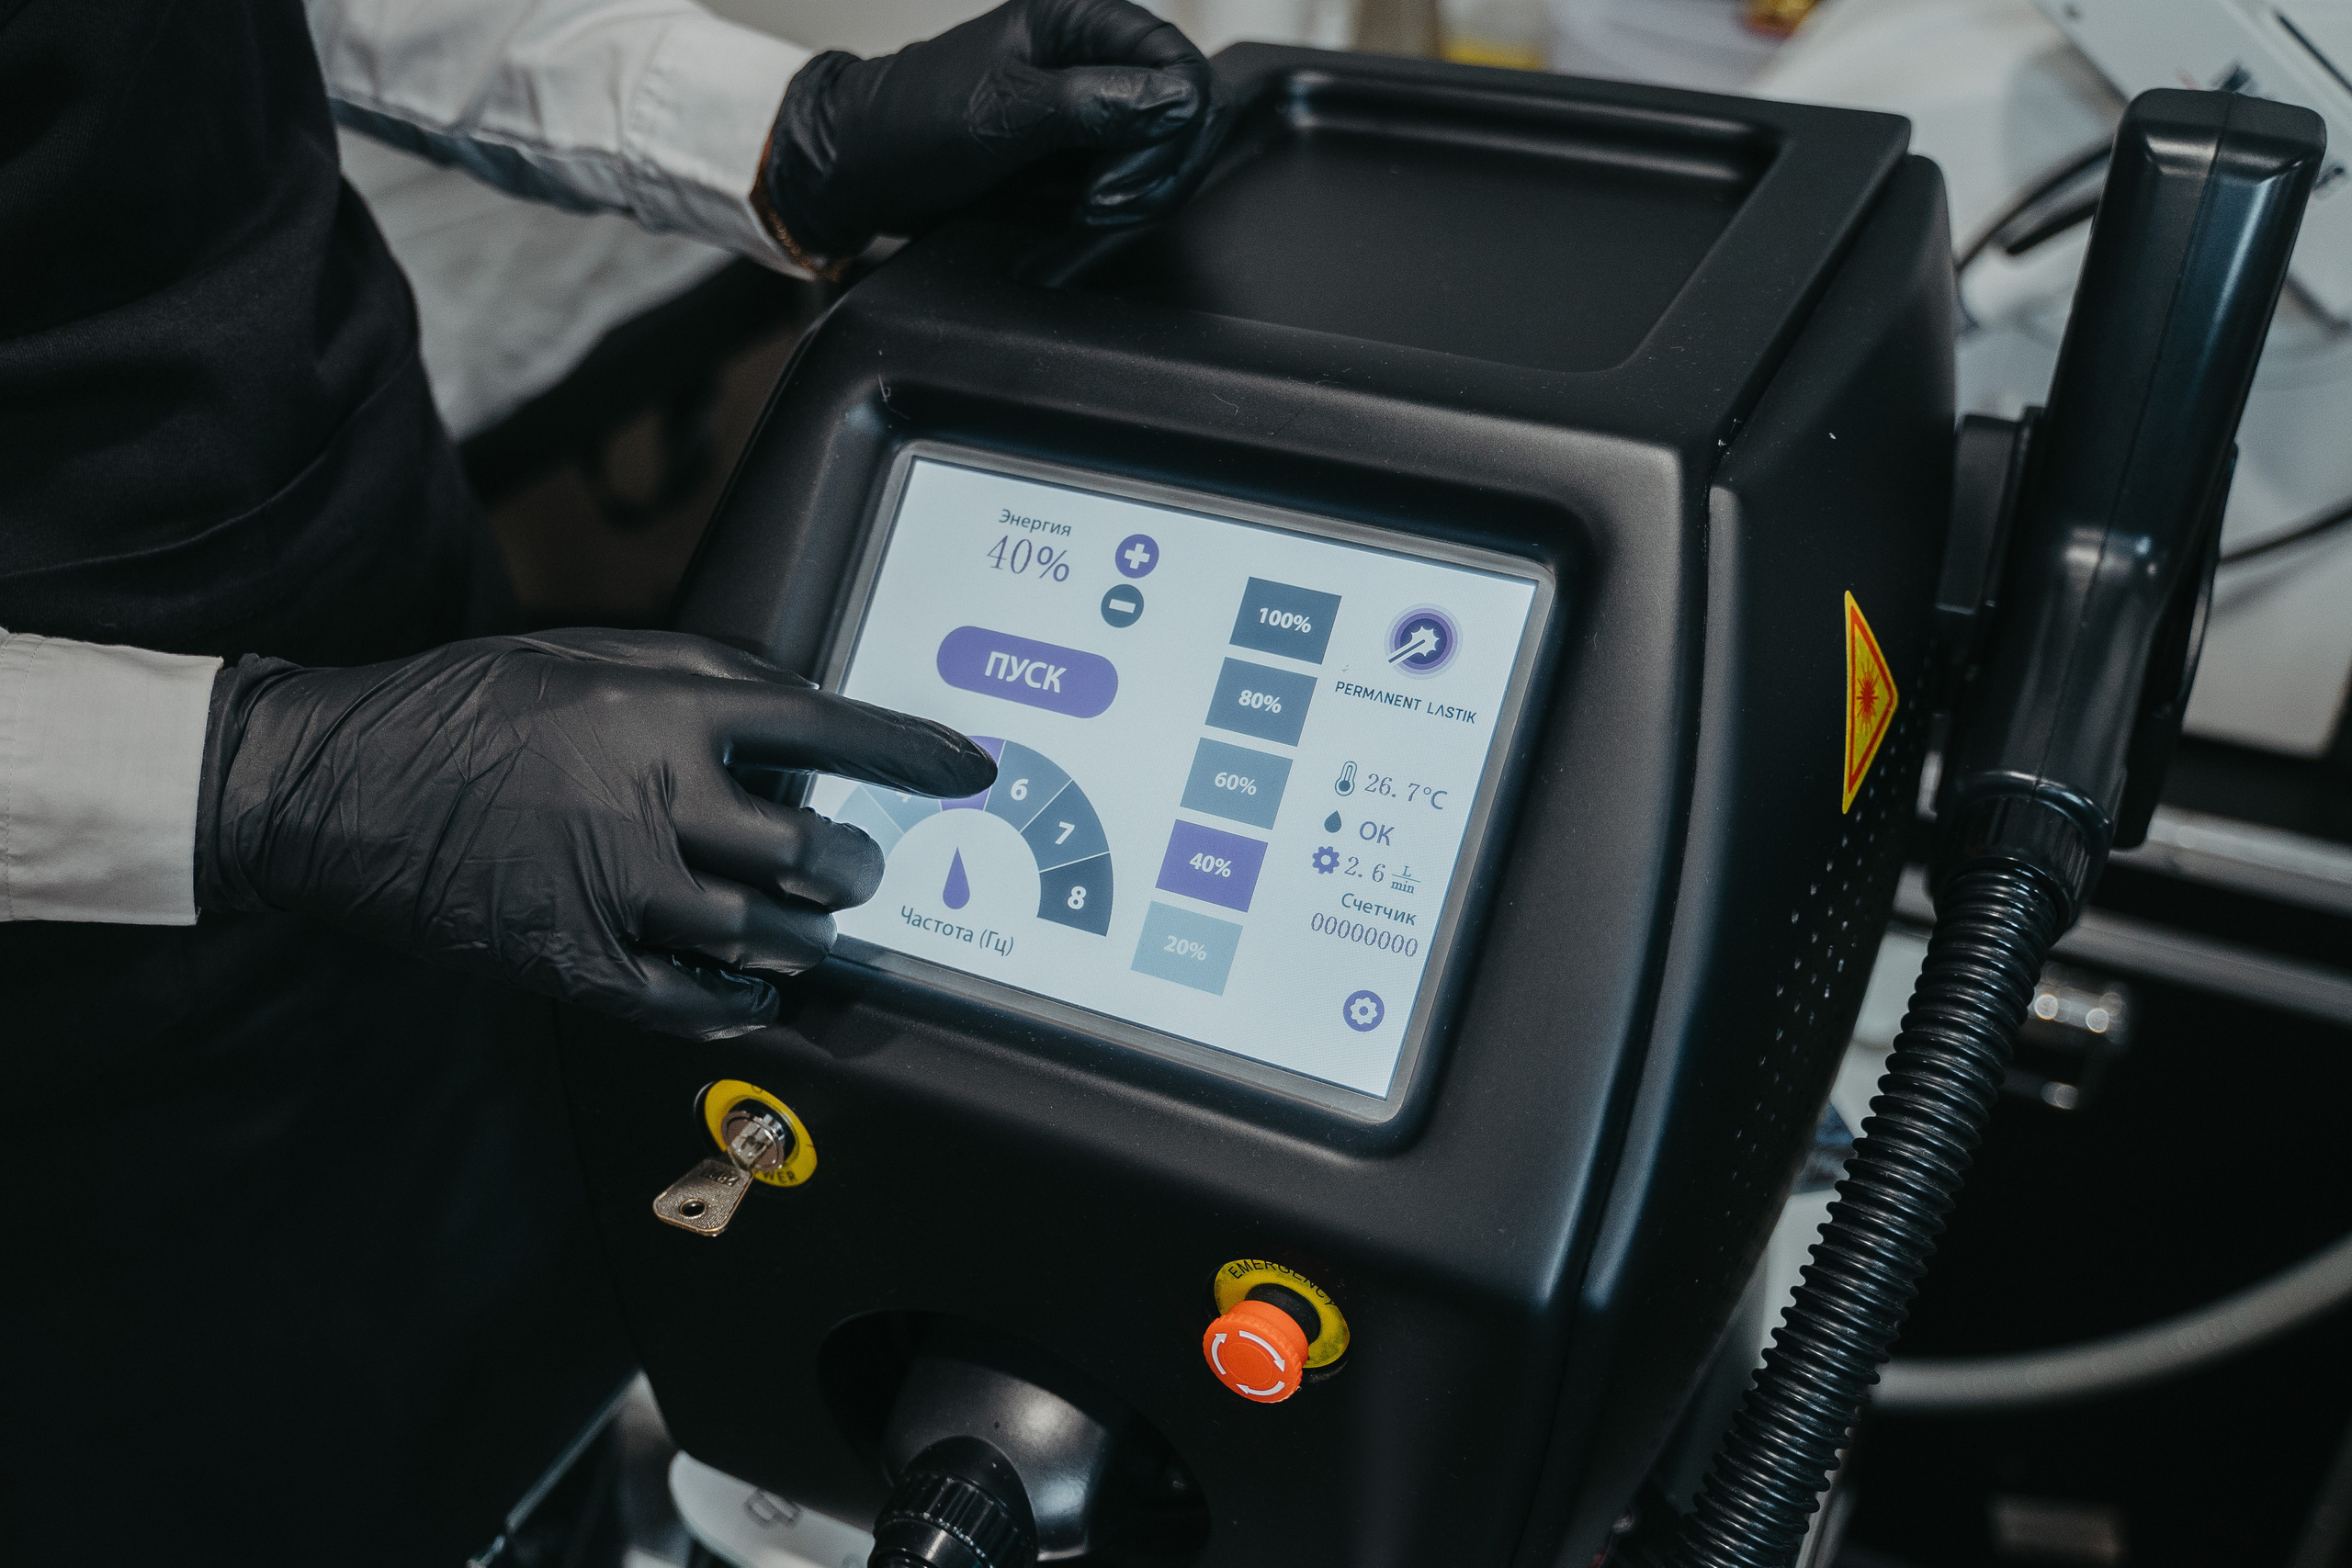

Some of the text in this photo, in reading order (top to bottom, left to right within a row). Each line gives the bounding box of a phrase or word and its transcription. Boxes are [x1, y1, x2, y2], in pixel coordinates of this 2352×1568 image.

[999, 509, 1071, 536] Энергия
[986, 535, 1070, 582] 40%
[1258, 606, 1312, 634] 100%
[984, 650, 1067, 694] ПУСК
[1238, 689, 1283, 714] 80%
[1335, 681, 1477, 725] PERMANENT LASTIK
[1010, 778, 1029, 801] 6
[1214, 771, 1257, 796] 60%
[1055, 821, 1075, 845] 7
[1359, 820, 1396, 846] OK
[1189, 852, 1232, 878] 40%
[1067, 886, 1087, 910] 8
[1340, 892, 1418, 926] Счетчик
[900, 905, 1014, 957] Частота (Гц)
[1310, 912, 1419, 958] 00000000
[1163, 935, 1207, 962] 20%
